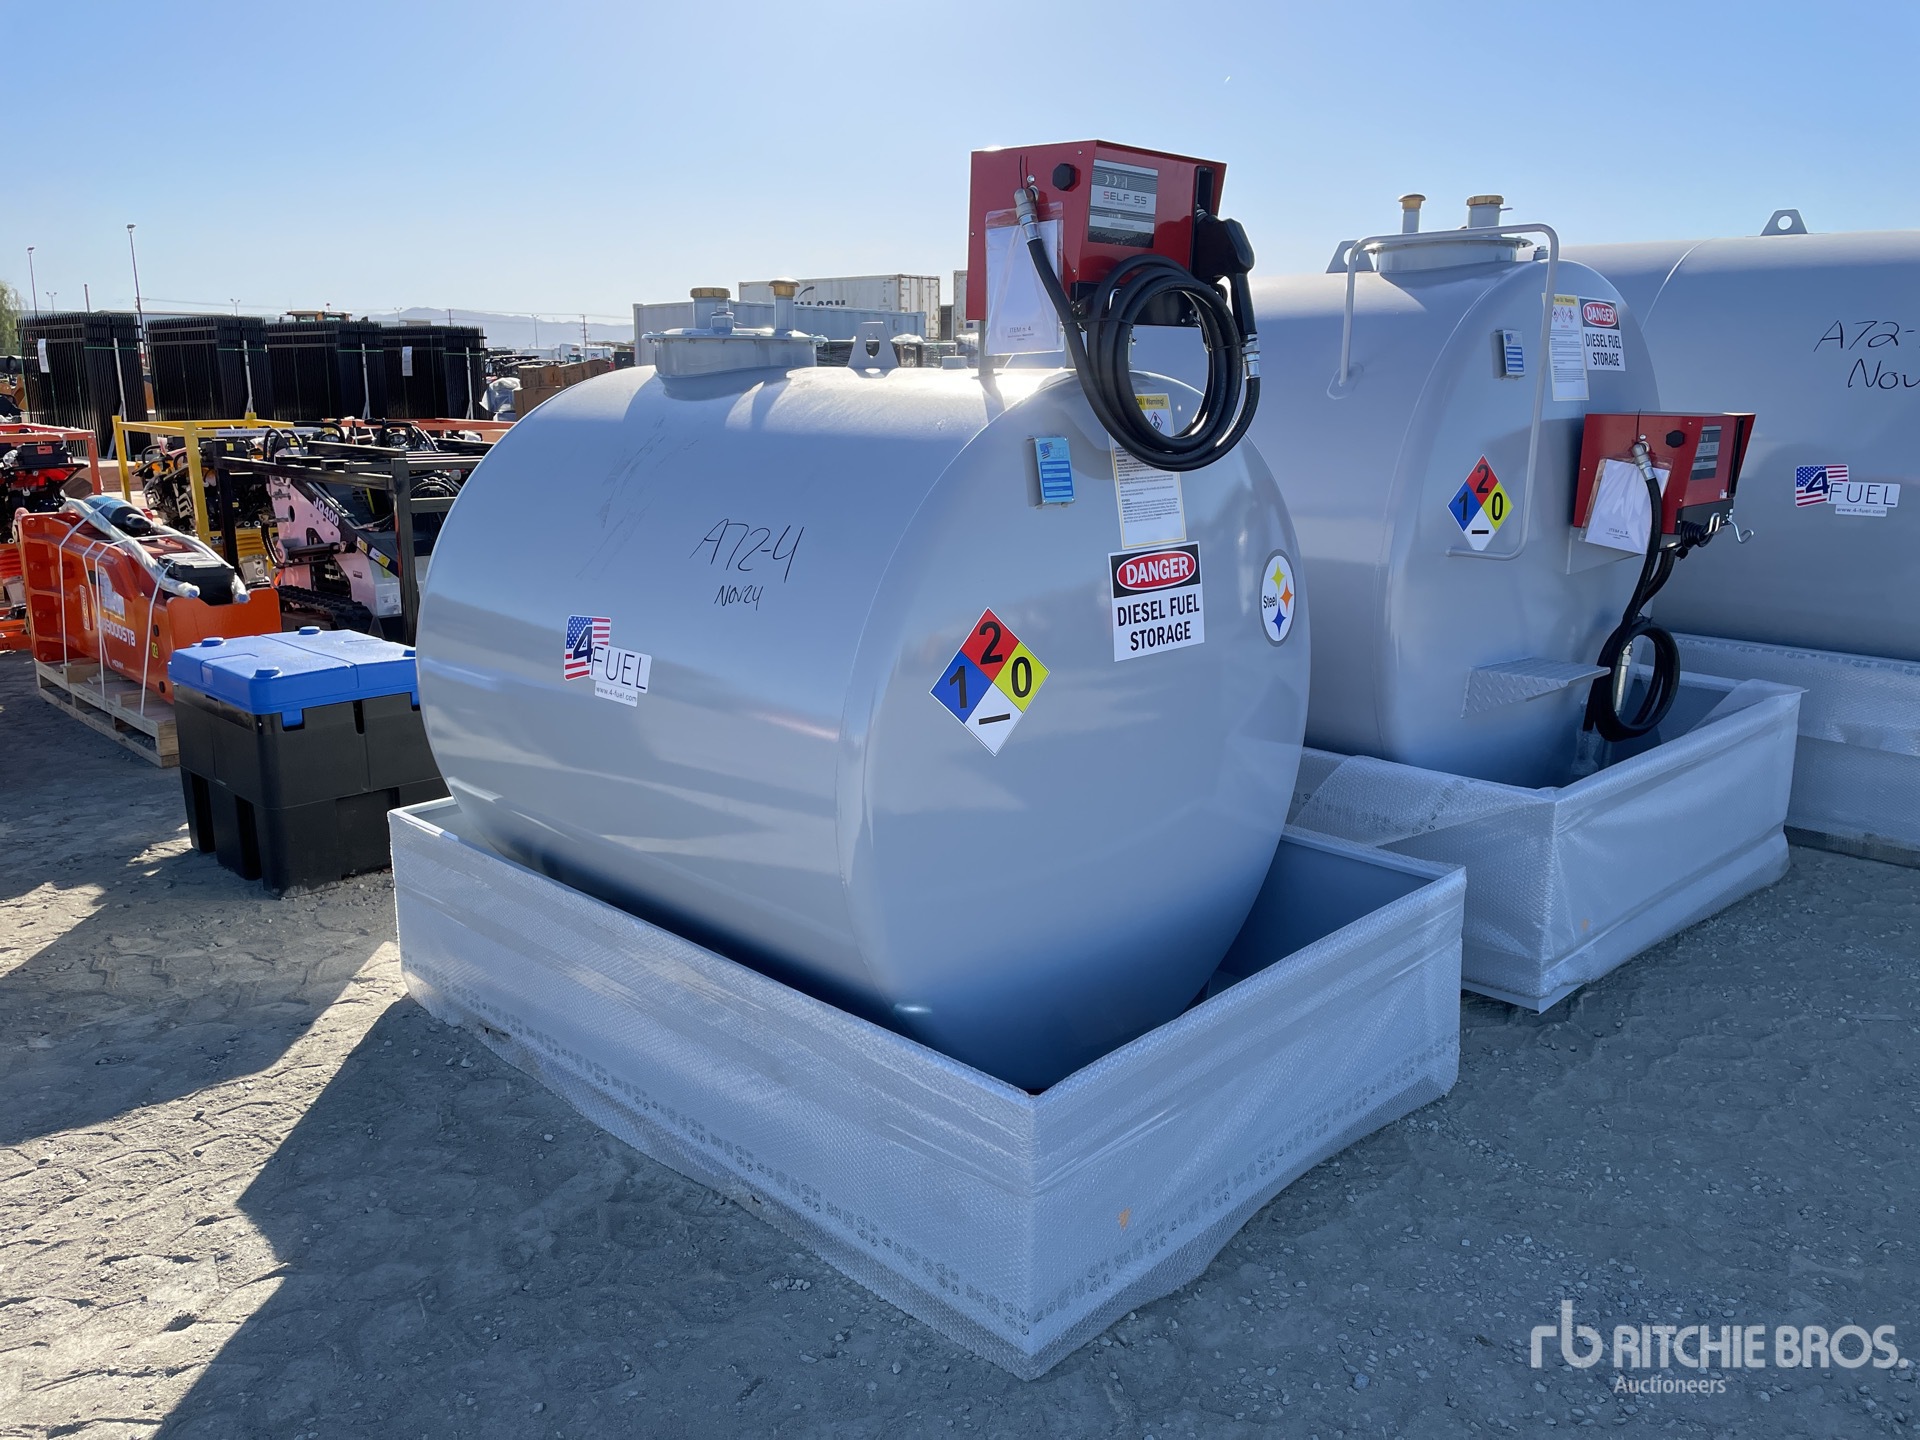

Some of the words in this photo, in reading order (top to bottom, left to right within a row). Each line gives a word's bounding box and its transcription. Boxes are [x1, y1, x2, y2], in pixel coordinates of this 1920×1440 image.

[1103, 191, 1130, 202] SELF
[1586, 306, 1615, 323] DANGER
[1585, 333, 1608, 348] DIESEL
[1608, 335, 1622, 349] FUEL
[1813, 319, 1920, 352] A72-
[1592, 351, 1620, 367] STORAGE
[1476, 464, 1489, 493] 2
[1805, 471, 1830, 495] 4
[1458, 491, 1468, 521] 1
[1491, 492, 1504, 521] 0
[1828, 483, 1896, 506] FUEL
[689, 518, 805, 583] A72-4
[1125, 556, 1189, 586] DANGER
[1117, 599, 1166, 627] DIESEL
[1169, 593, 1200, 617] FUEL
[1263, 593, 1277, 609] Steel
[572, 625, 593, 664] 4
[979, 621, 1003, 665] 2
[1130, 621, 1192, 651] STORAGE
[591, 646, 647, 690] FUEL
[949, 665, 968, 709] 1
[1011, 656, 1033, 699] 0
[596, 686, 637, 702] www.4-fuel.com
